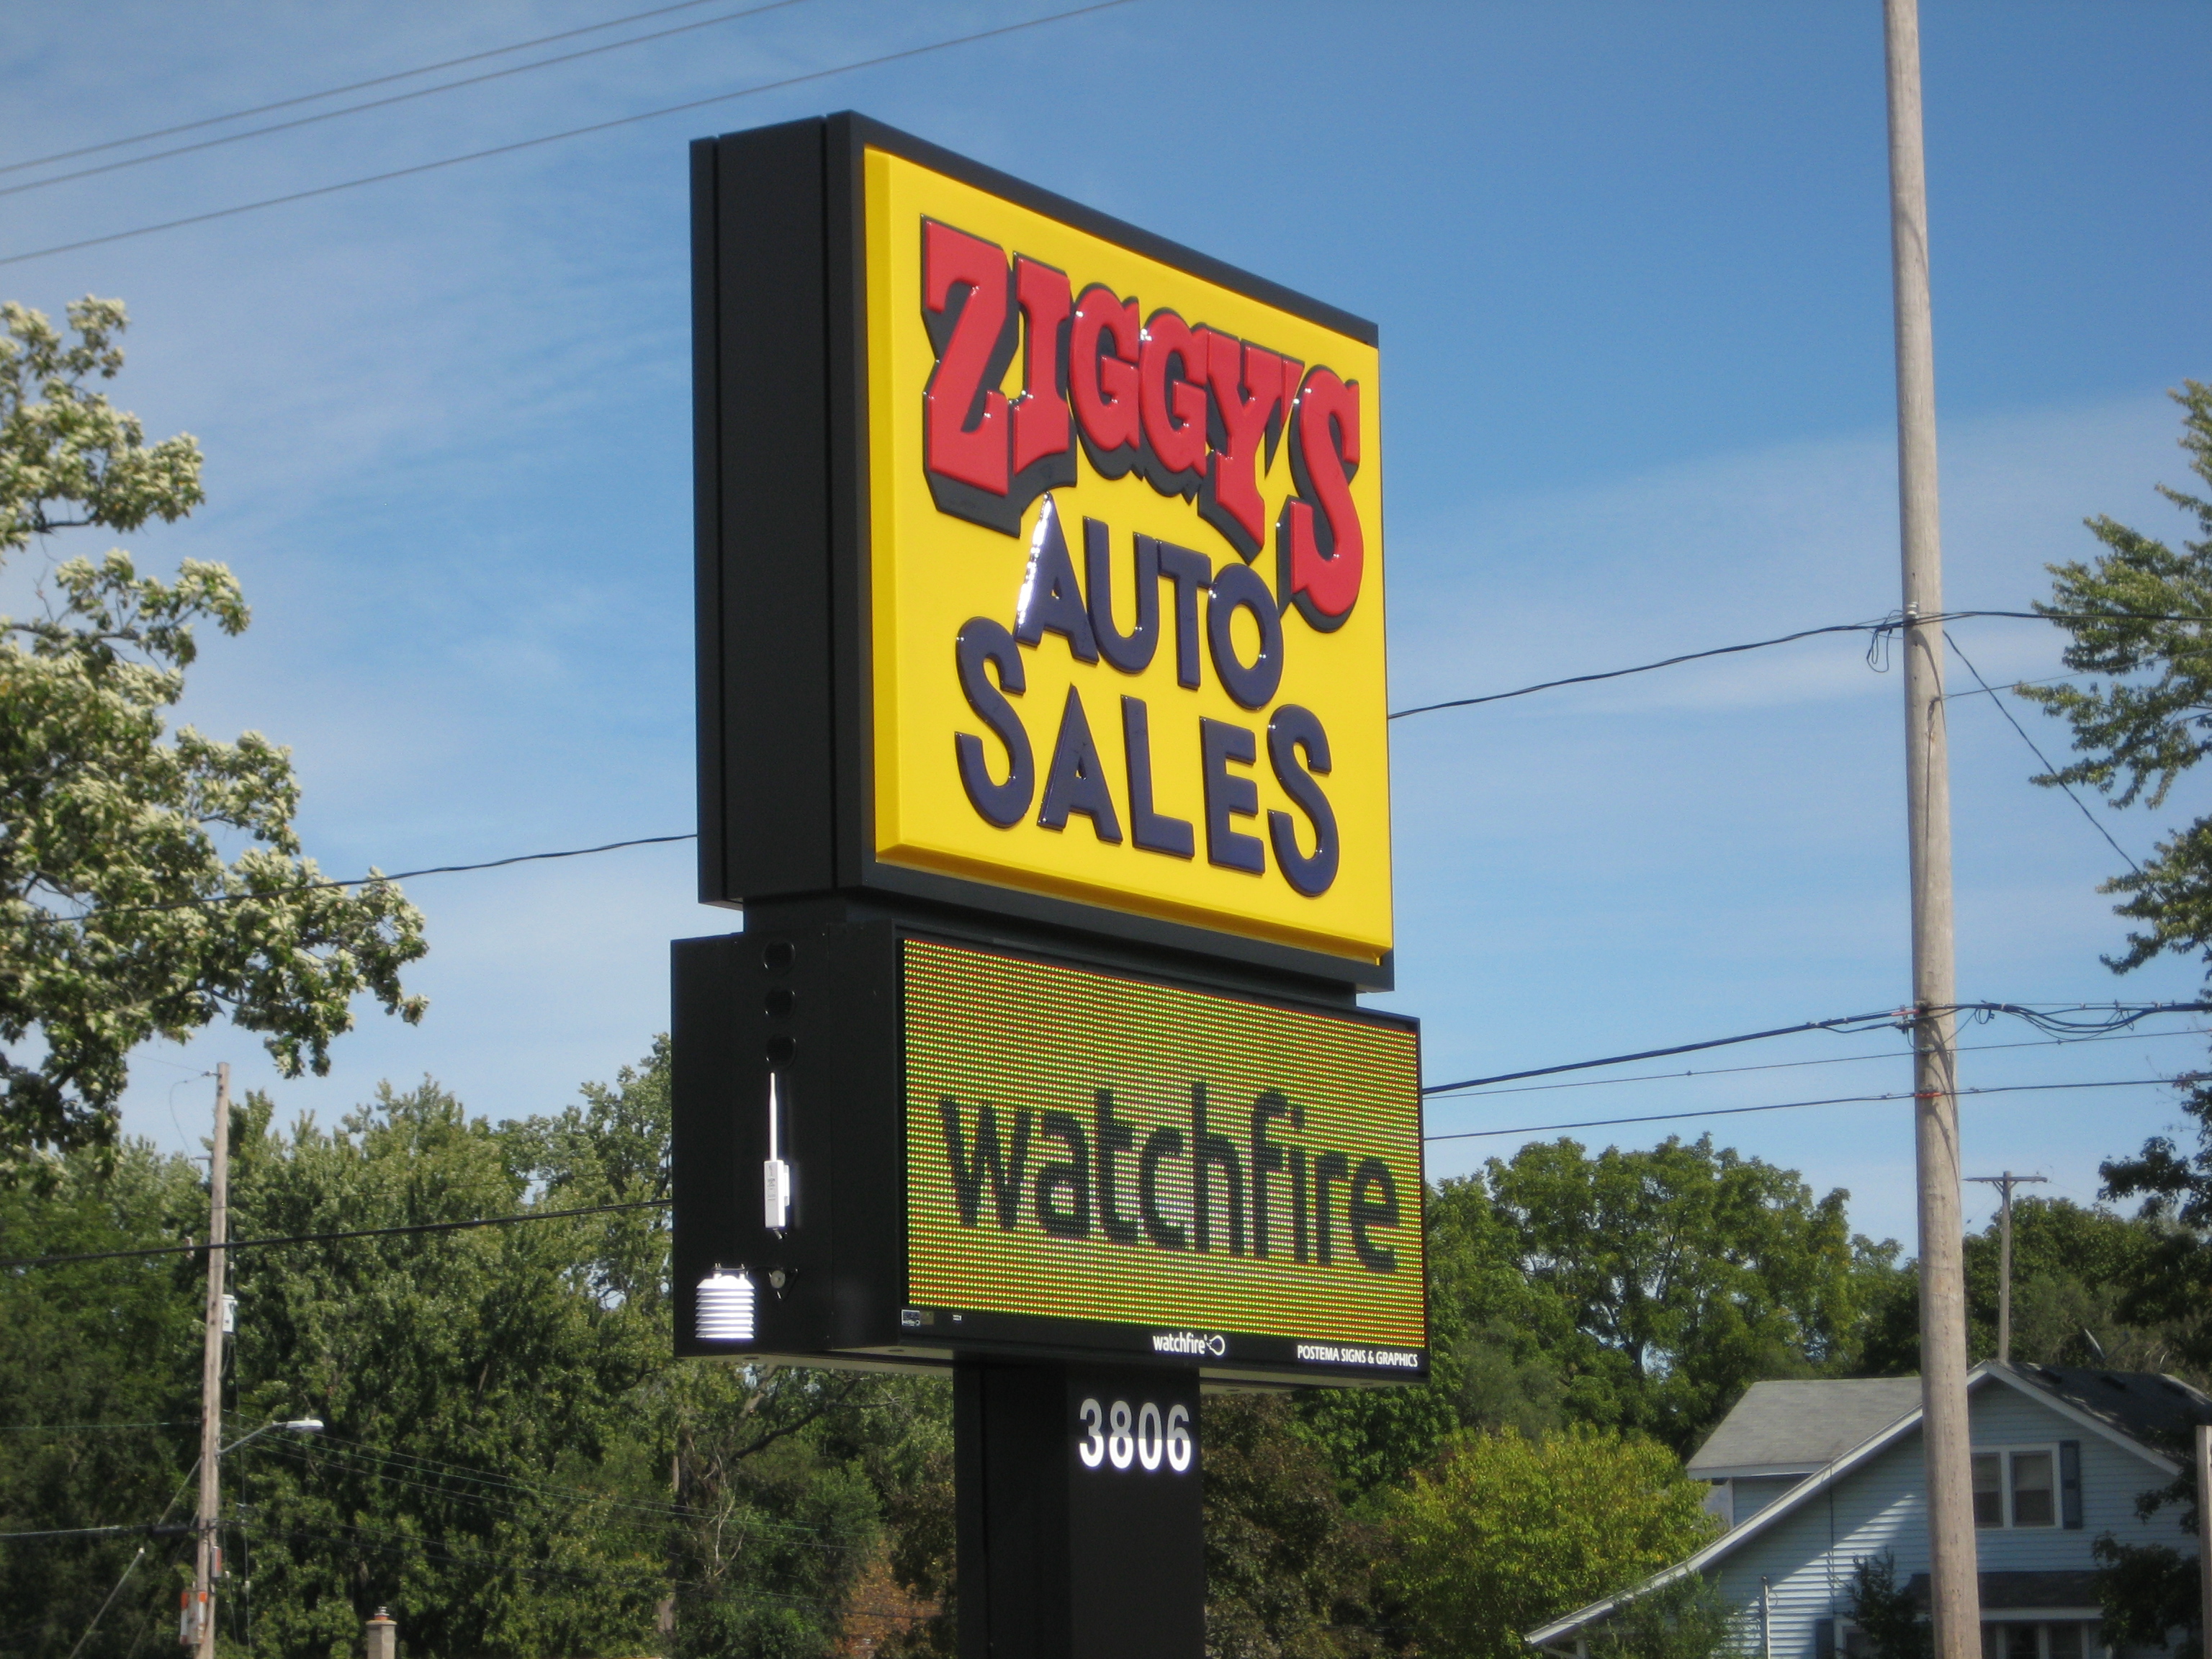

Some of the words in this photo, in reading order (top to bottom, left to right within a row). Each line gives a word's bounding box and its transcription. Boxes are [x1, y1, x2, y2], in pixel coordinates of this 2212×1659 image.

[922, 215, 1364, 632] ZIGGY'S
[1013, 491, 1283, 709] AUTO
[954, 616, 1340, 897] SALES
[938, 1080, 1401, 1272] watchfire
[1079, 1397, 1192, 1471] 3806
[1153, 1331, 1206, 1354] watchfire
[1297, 1344, 1339, 1362] POSTEMA
[1341, 1348, 1366, 1364] SIGNS
[1367, 1350, 1375, 1364] &
[1375, 1351, 1419, 1367] GRAPHICS
